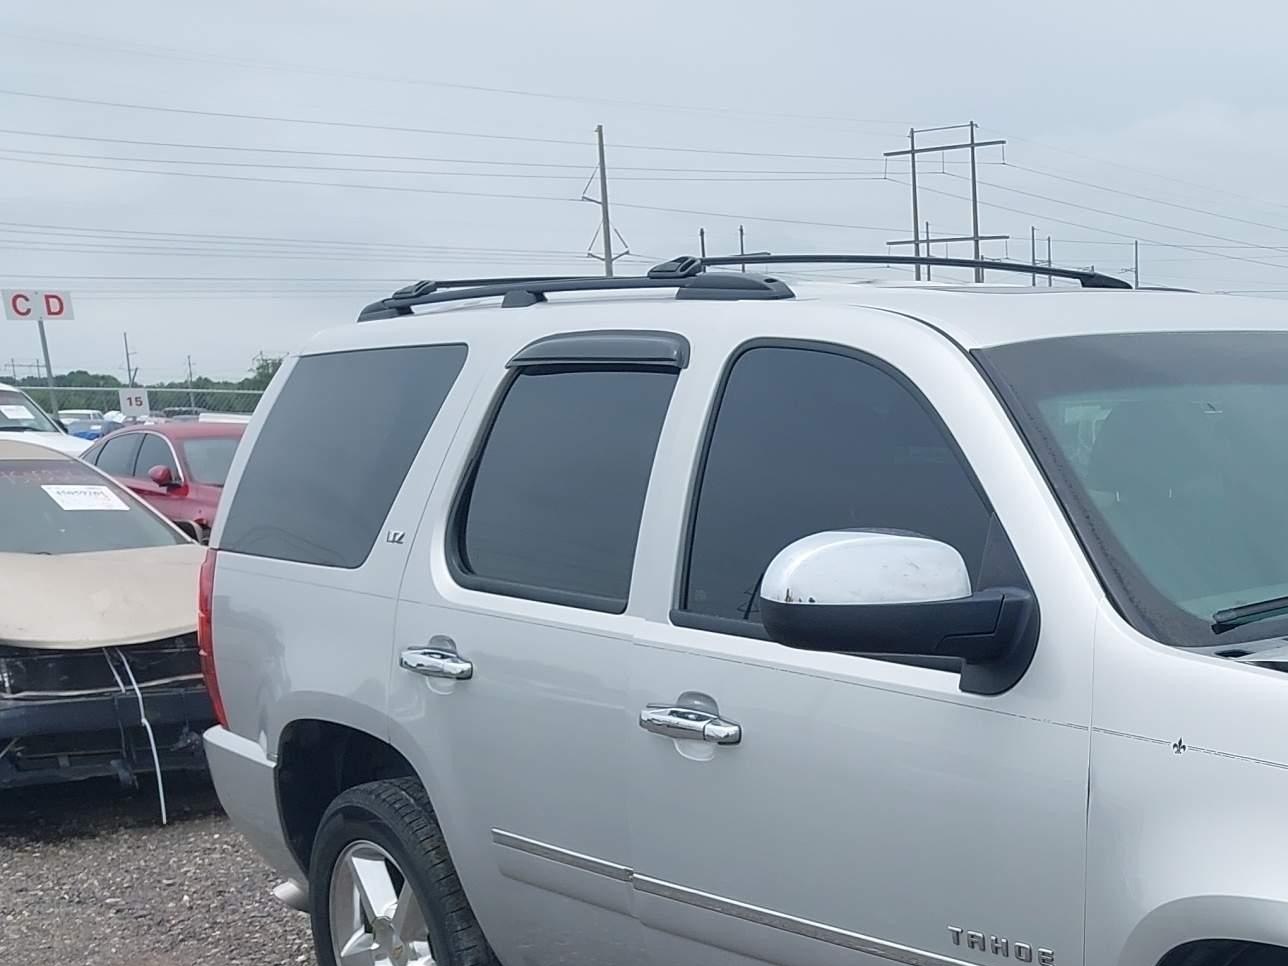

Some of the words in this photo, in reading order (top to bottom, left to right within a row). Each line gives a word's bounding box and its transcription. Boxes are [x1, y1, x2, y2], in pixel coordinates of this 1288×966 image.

[12, 294, 31, 316] C
[44, 294, 64, 315] D
[126, 396, 143, 407] 15
